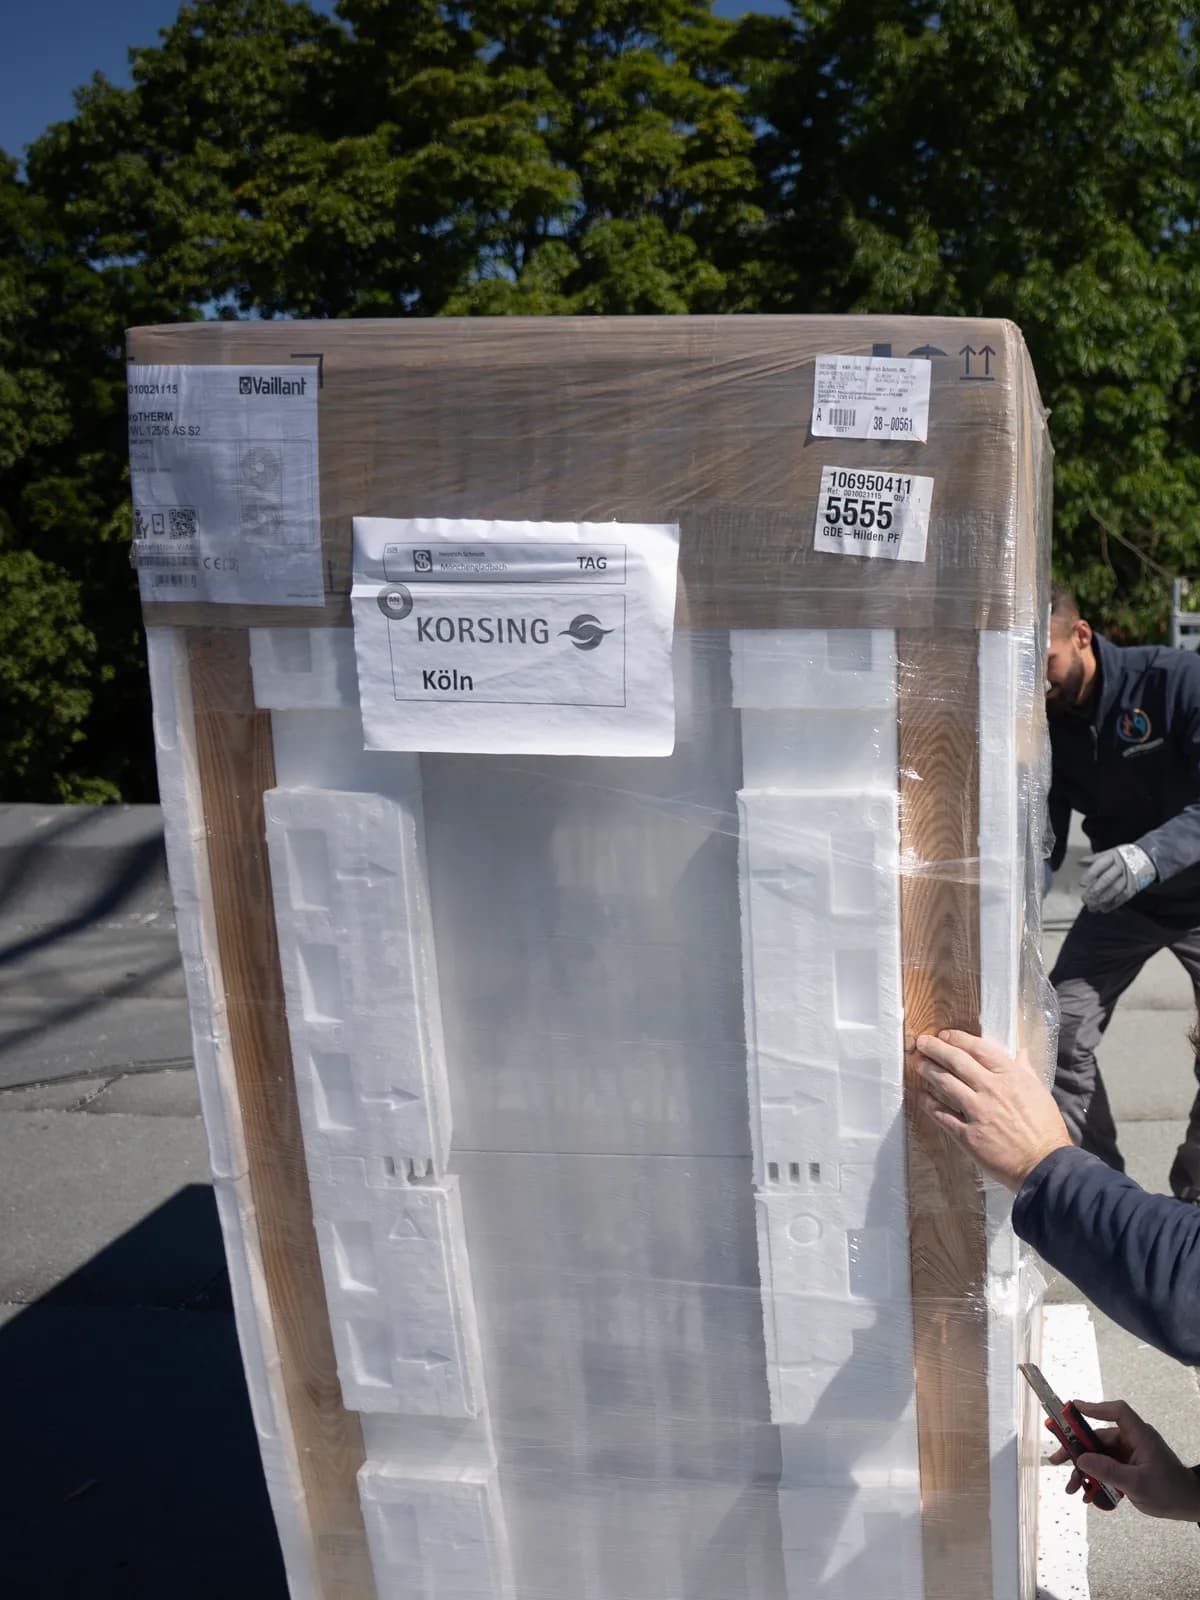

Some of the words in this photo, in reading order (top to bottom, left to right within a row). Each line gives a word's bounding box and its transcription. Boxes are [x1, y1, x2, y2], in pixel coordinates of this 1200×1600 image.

[252, 376, 307, 395] Vaillant
[172, 425, 186, 437] AS
[188, 425, 201, 437] S2
[873, 416, 913, 432] 38-00561
[830, 471, 911, 494] 106950411
[825, 496, 893, 530] 5555
[887, 532, 900, 544] PF
[577, 556, 608, 570] TAG
[417, 616, 549, 644] KORSING
[422, 669, 474, 691] Köln
